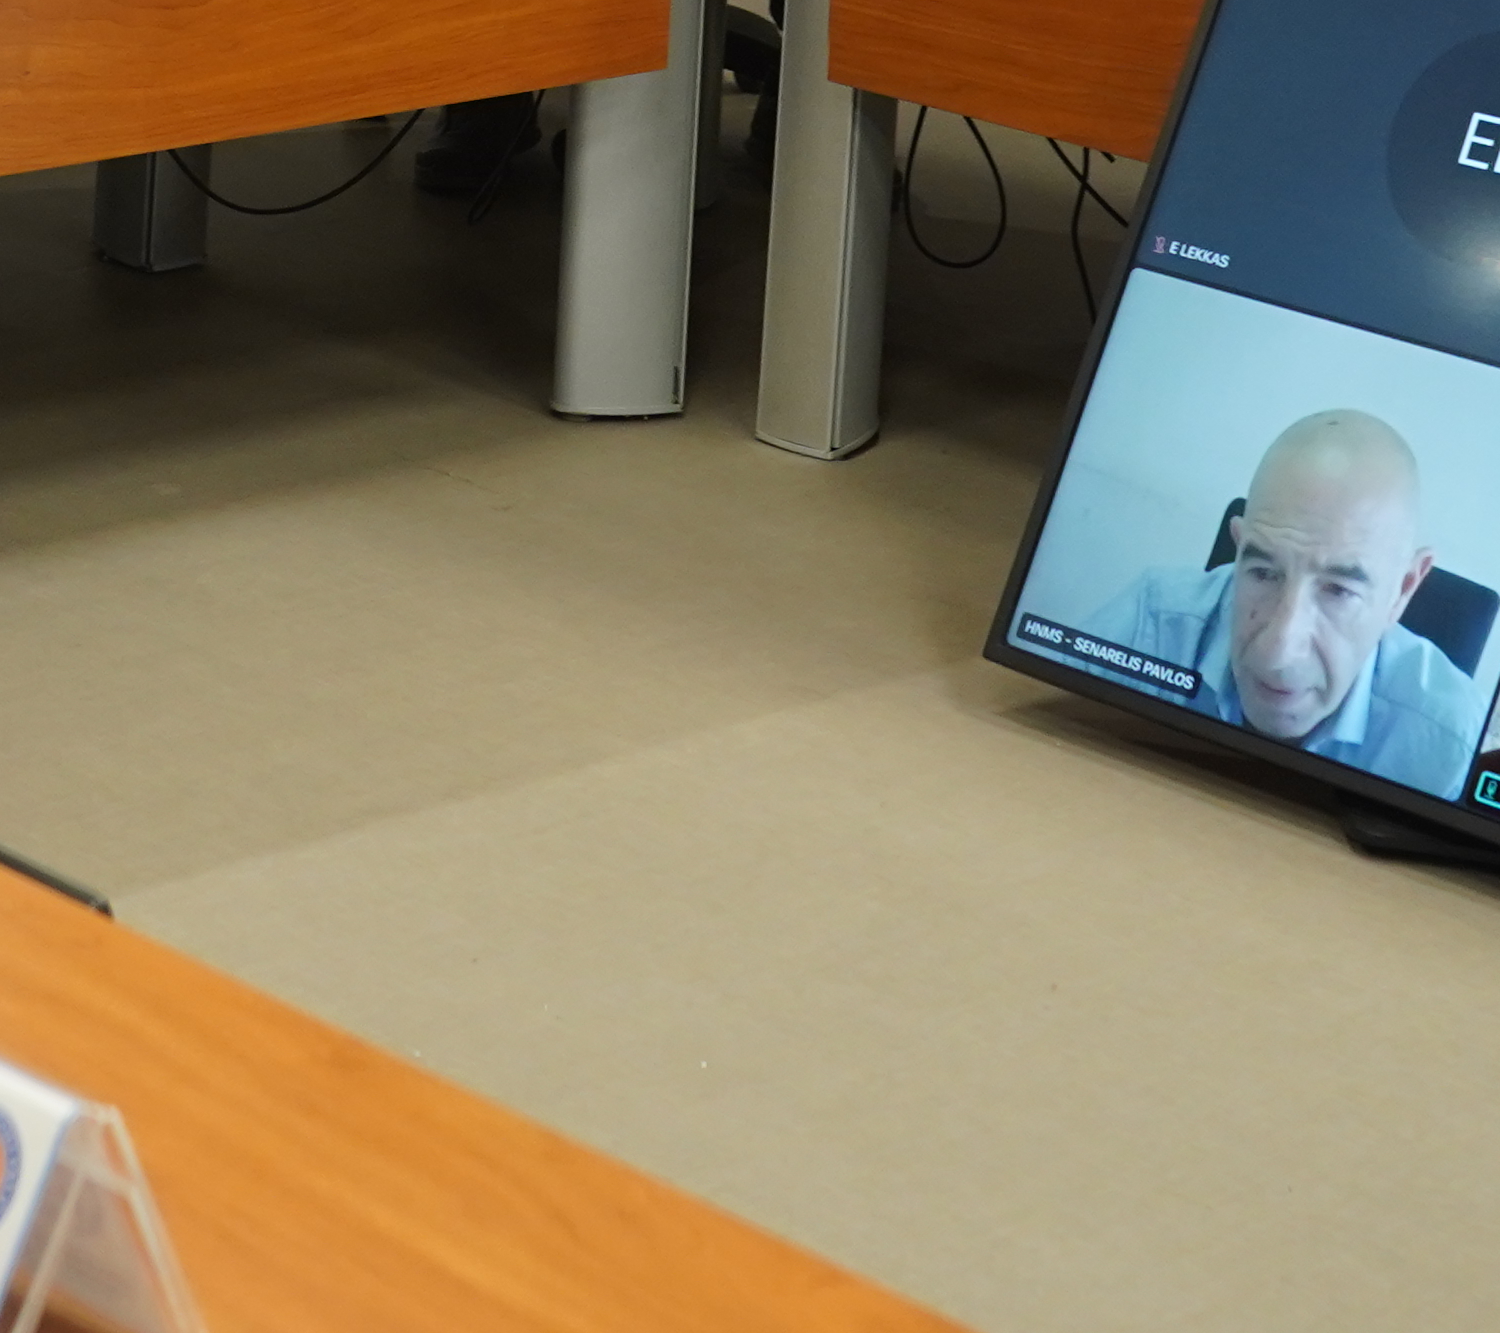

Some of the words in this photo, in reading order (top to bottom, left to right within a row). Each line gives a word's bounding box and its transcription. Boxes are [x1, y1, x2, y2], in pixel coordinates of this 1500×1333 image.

[1180, 243, 1231, 269] LEKKAS
[1024, 619, 1063, 644] HNMS
[1073, 636, 1142, 672] SENARELIS
[1142, 660, 1195, 690] PAVLOS
